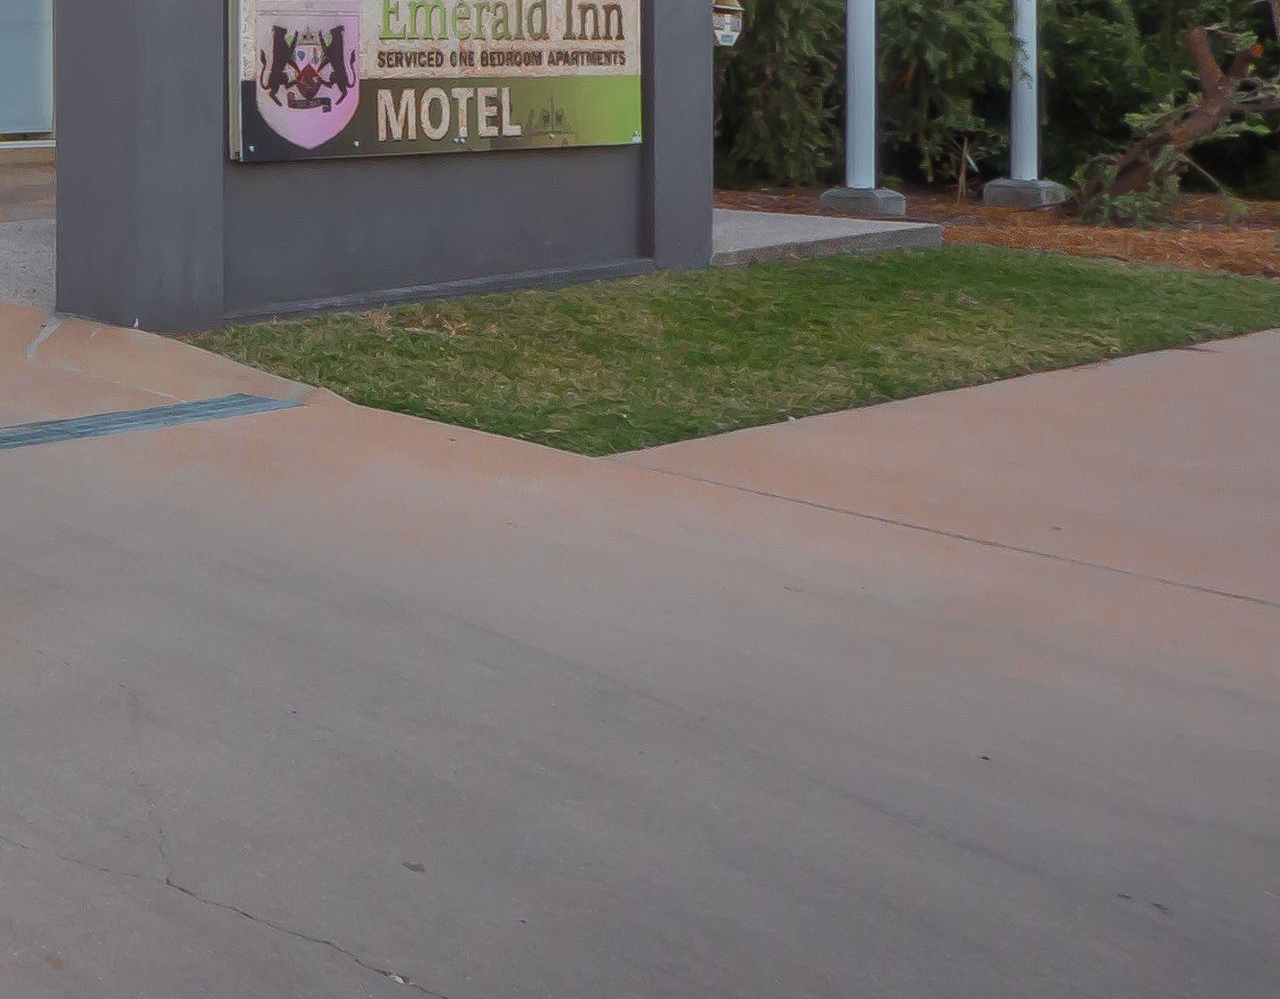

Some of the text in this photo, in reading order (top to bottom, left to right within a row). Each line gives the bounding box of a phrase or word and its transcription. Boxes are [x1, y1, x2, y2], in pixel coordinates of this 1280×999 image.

[376, 50, 627, 68] SERVICED ONE BEDROOM APARTMENTS
[376, 86, 523, 142] MOTEL
